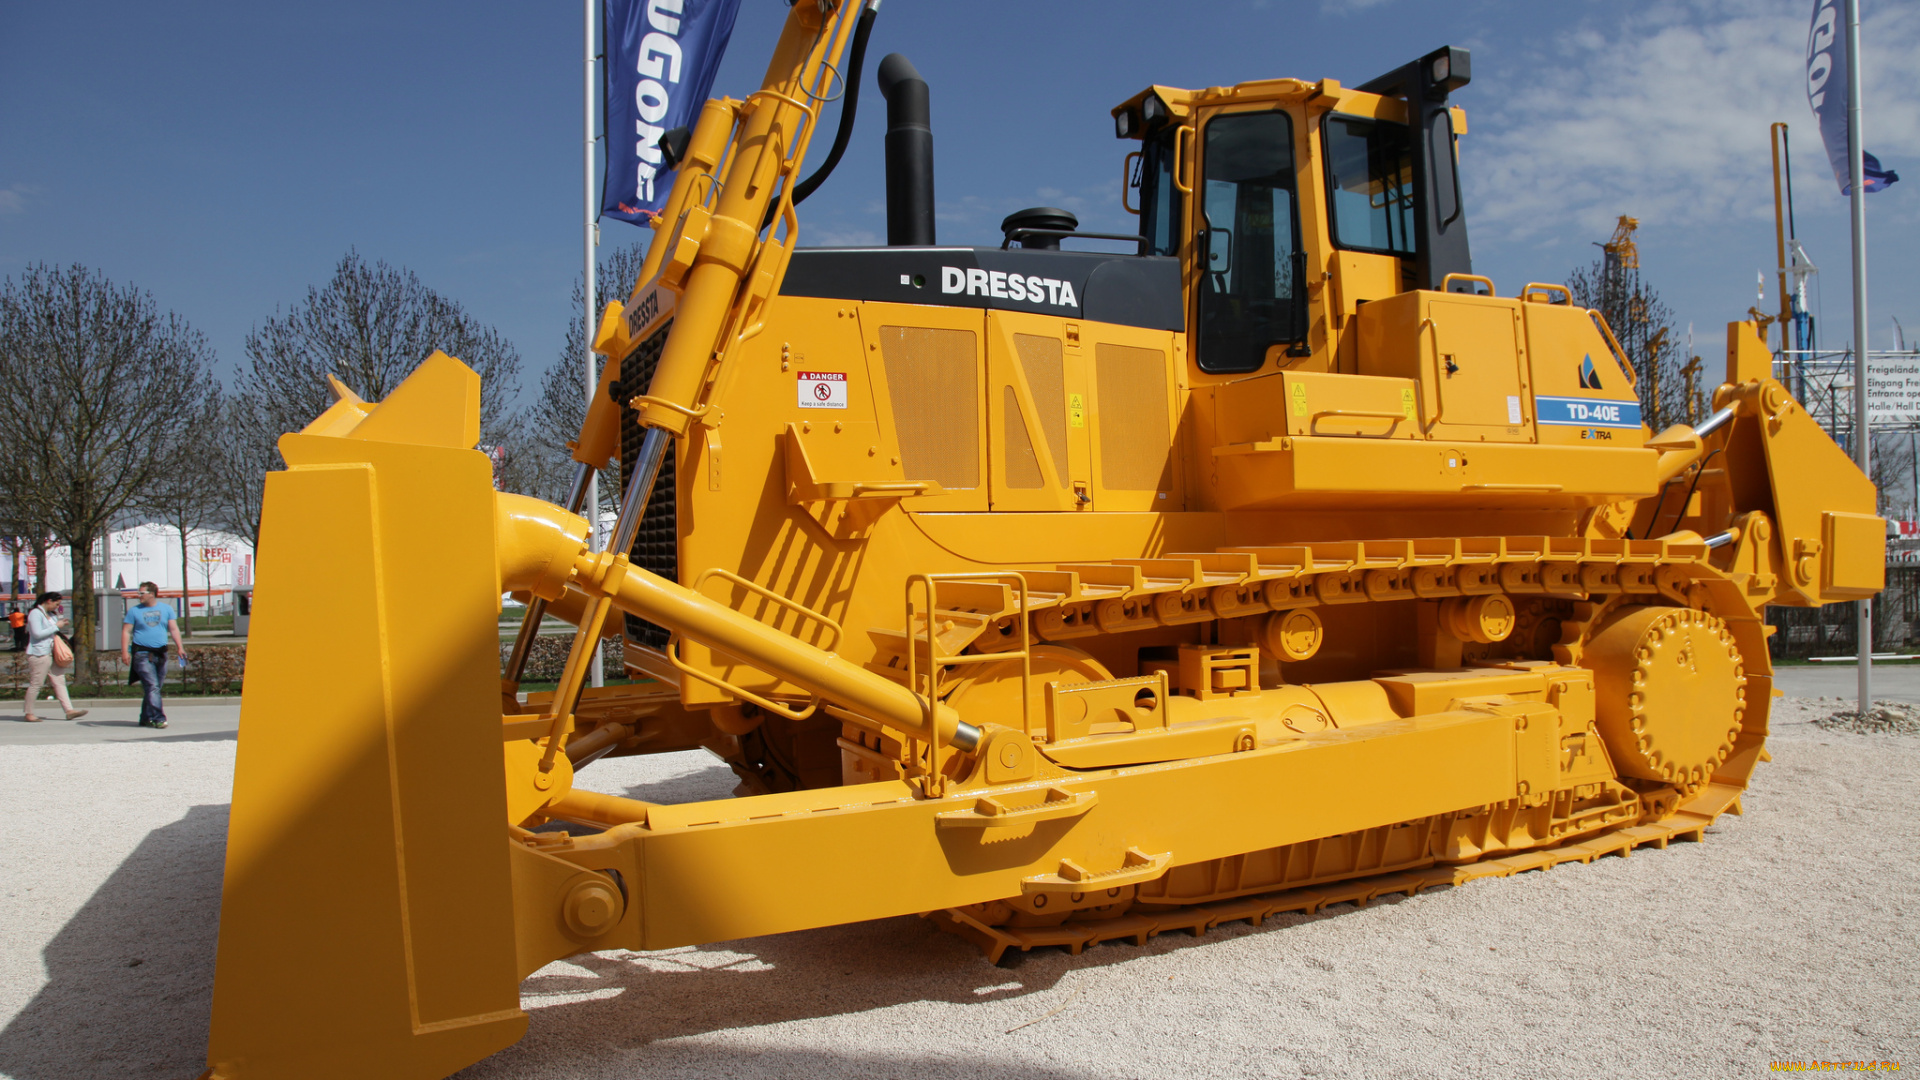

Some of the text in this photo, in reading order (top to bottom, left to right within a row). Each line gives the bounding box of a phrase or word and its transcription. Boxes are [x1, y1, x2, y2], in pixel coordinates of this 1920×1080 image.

[941, 265, 1079, 308] DRESSTA
[628, 289, 659, 340] DRESSTA
[1867, 364, 1919, 376] Freigelände
[1867, 378, 1903, 388] Eingang
[1867, 389, 1904, 397] Entrance
[1867, 402, 1914, 410] Halle/Hall
[1566, 403, 1621, 422] TD-40E
[1580, 428, 1612, 440] EXTRA
